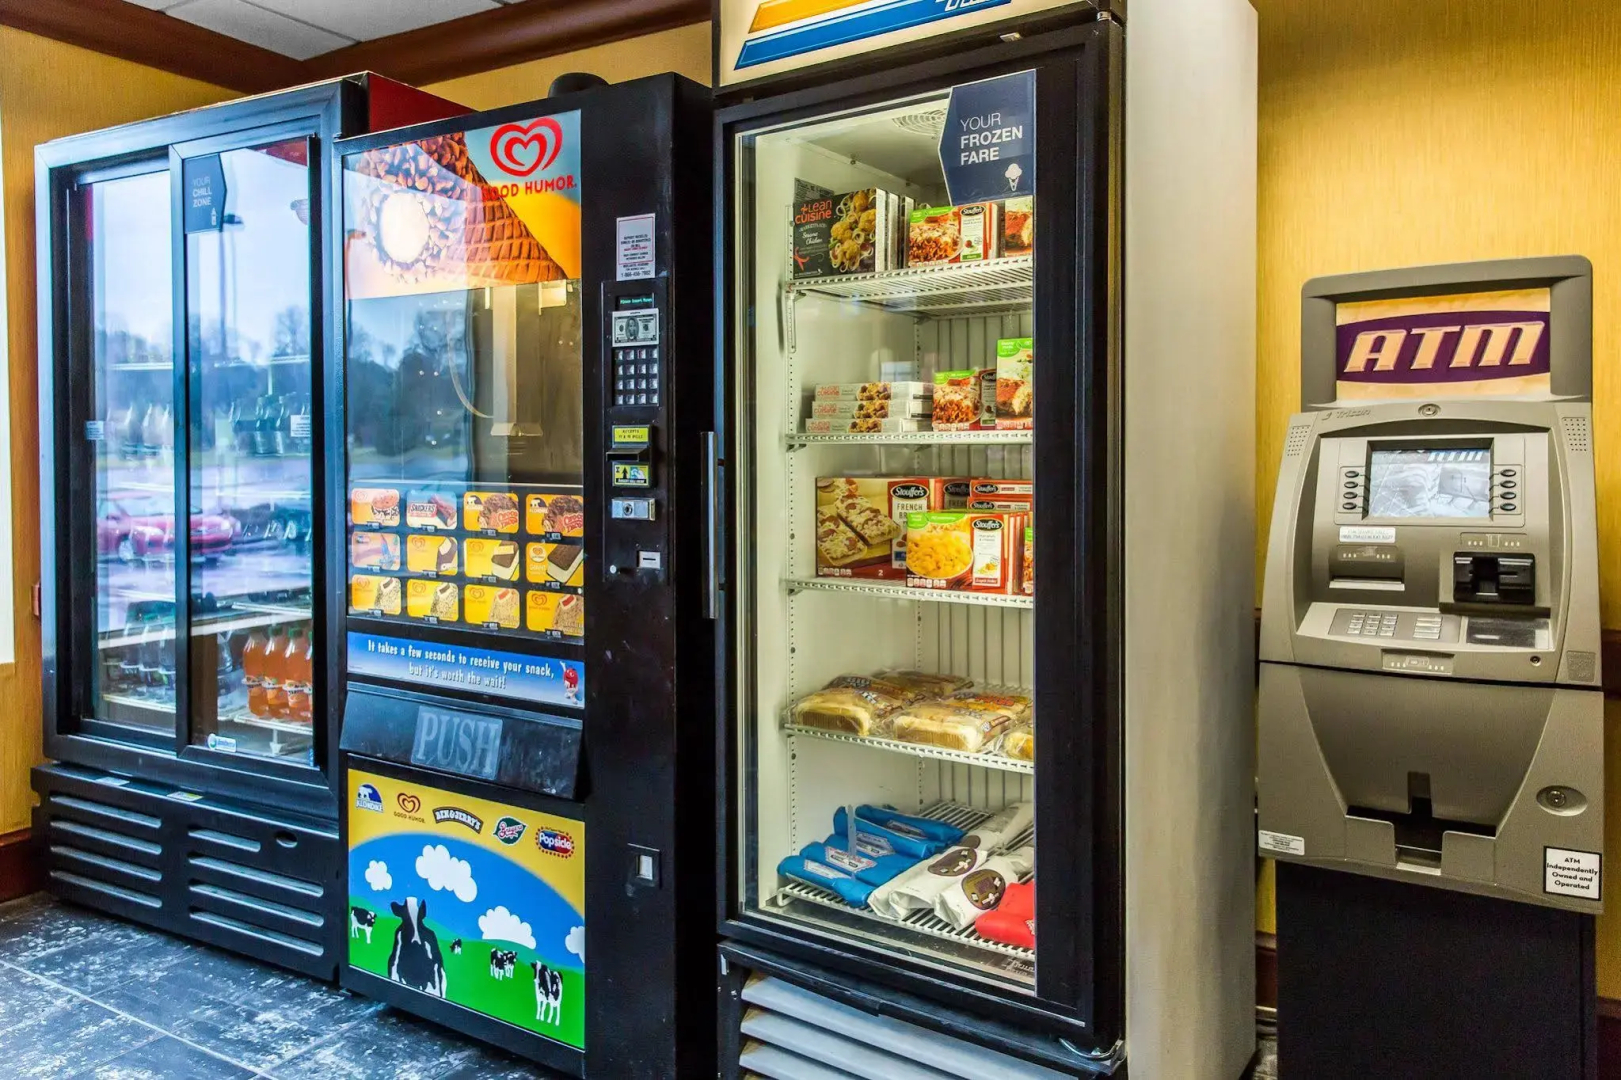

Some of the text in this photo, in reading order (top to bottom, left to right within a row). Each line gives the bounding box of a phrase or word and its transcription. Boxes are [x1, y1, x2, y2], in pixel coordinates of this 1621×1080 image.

[960, 112, 1001, 131] YOUR
[961, 126, 1023, 149] FROZEN
[961, 147, 999, 165] FARE
[193, 176, 210, 186] YOUR
[193, 187, 212, 197] CHILL
[481, 183, 519, 202] GOOD
[193, 196, 211, 207] ZONE
[1344, 321, 1545, 373] ATM
[895, 485, 925, 497] Stouffer's
[368, 639, 555, 678] It takes a few seconds to receive your snack,
[409, 662, 507, 690] but it's worth the wait!
[417, 711, 499, 774] PUSH
[356, 800, 384, 812] KLONDIKE
[394, 811, 407, 819] GOOD
[540, 831, 572, 850] Popsicle
[1546, 863, 1598, 875] Independently
[1552, 871, 1577, 880] Owned
[1554, 879, 1589, 890] Operated
